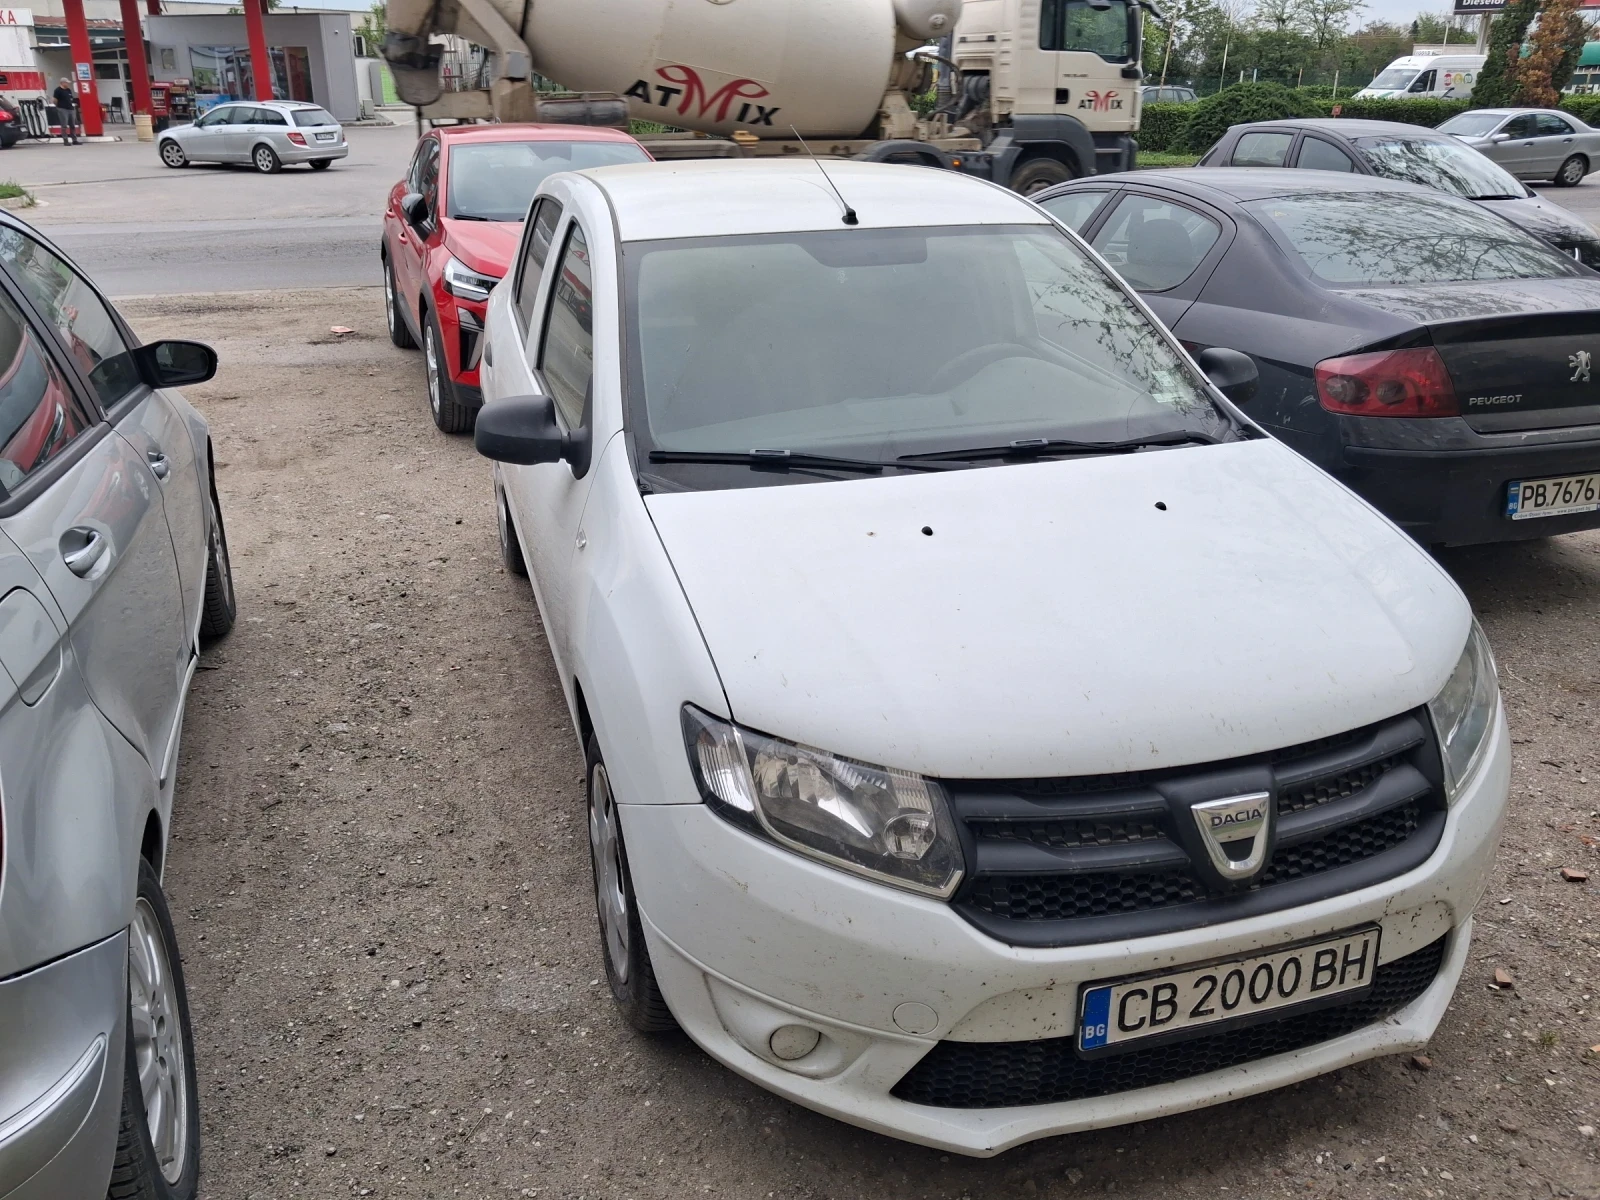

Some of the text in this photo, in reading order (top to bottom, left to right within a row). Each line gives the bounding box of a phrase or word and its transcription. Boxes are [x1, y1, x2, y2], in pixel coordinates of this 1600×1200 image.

[82, 82, 90, 93] 3
[624, 65, 781, 126] ATMIX
[1078, 90, 1123, 112] ATMIX
[1469, 394, 1522, 406] PEUGEOT
[1521, 484, 1547, 509] PB
[1550, 478, 1595, 506] 7676
[1210, 808, 1262, 827] DACIA
[1117, 939, 1369, 1033] CB 2000 BH
[1085, 1024, 1106, 1040] BG
